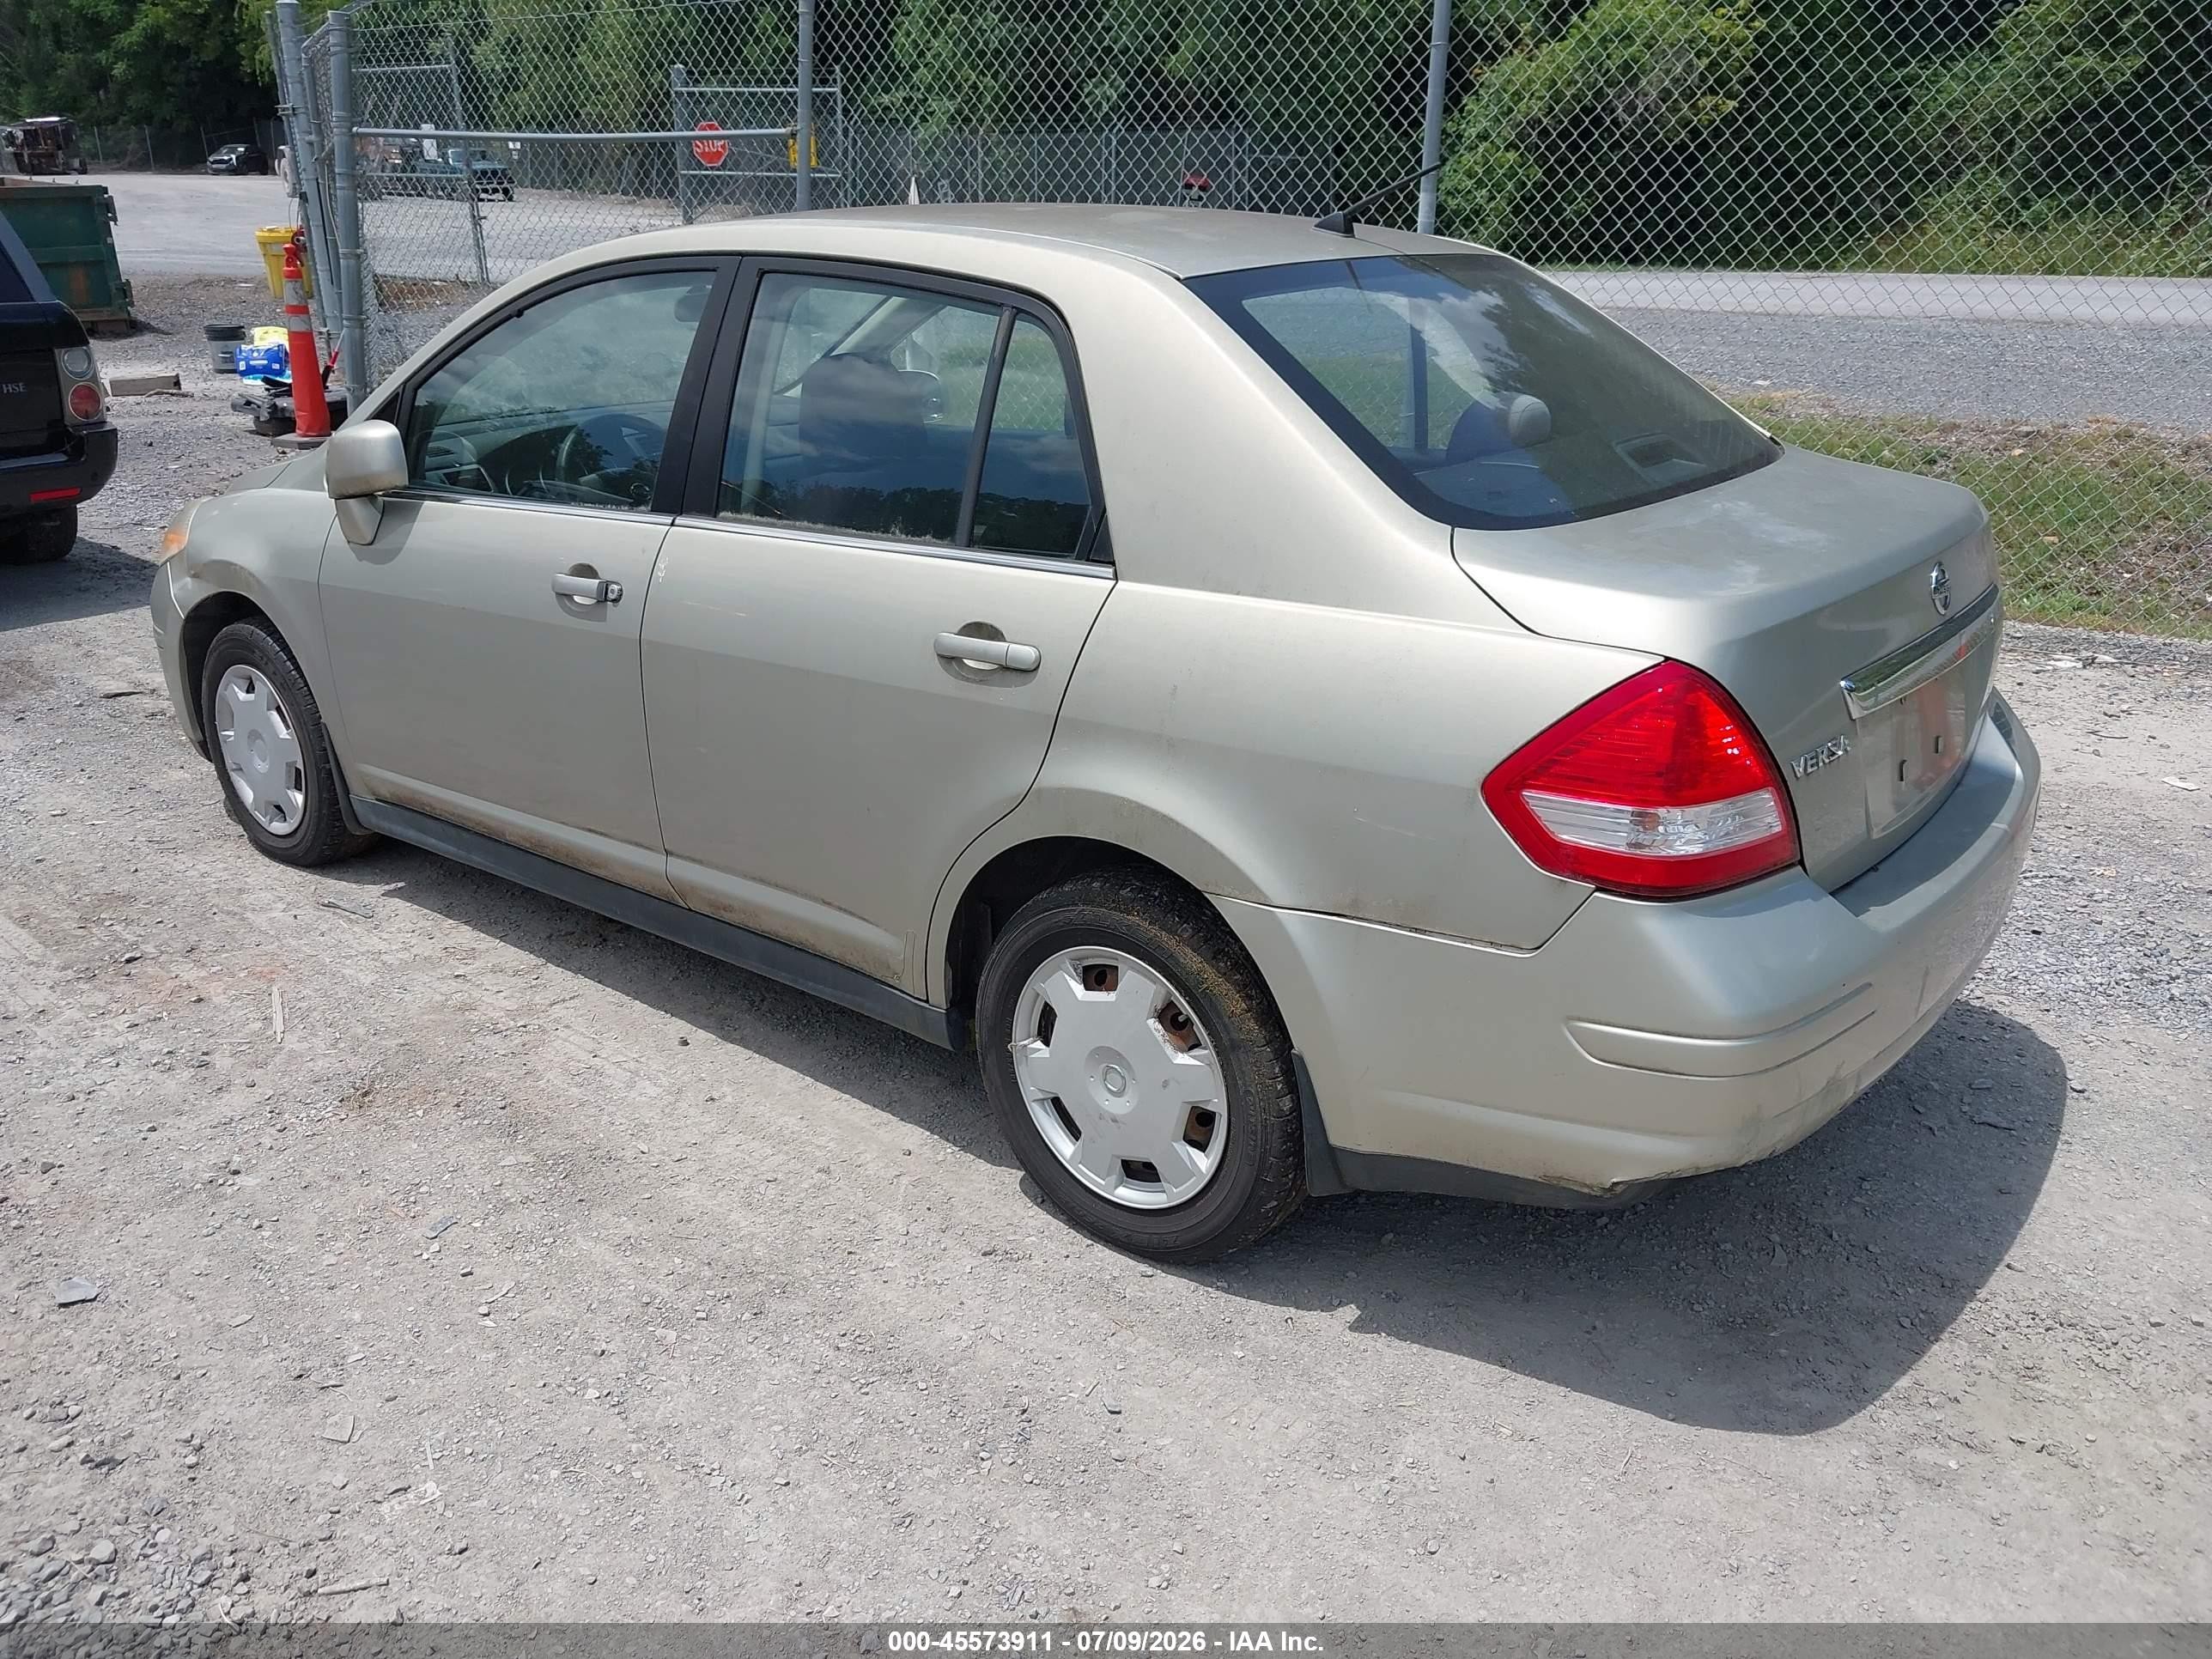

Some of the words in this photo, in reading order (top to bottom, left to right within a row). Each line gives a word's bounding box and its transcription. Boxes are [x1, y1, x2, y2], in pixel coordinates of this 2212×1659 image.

[695, 139, 726, 153] STOP
[3, 383, 27, 393] HSE
[1790, 734, 1851, 780] VERSA
